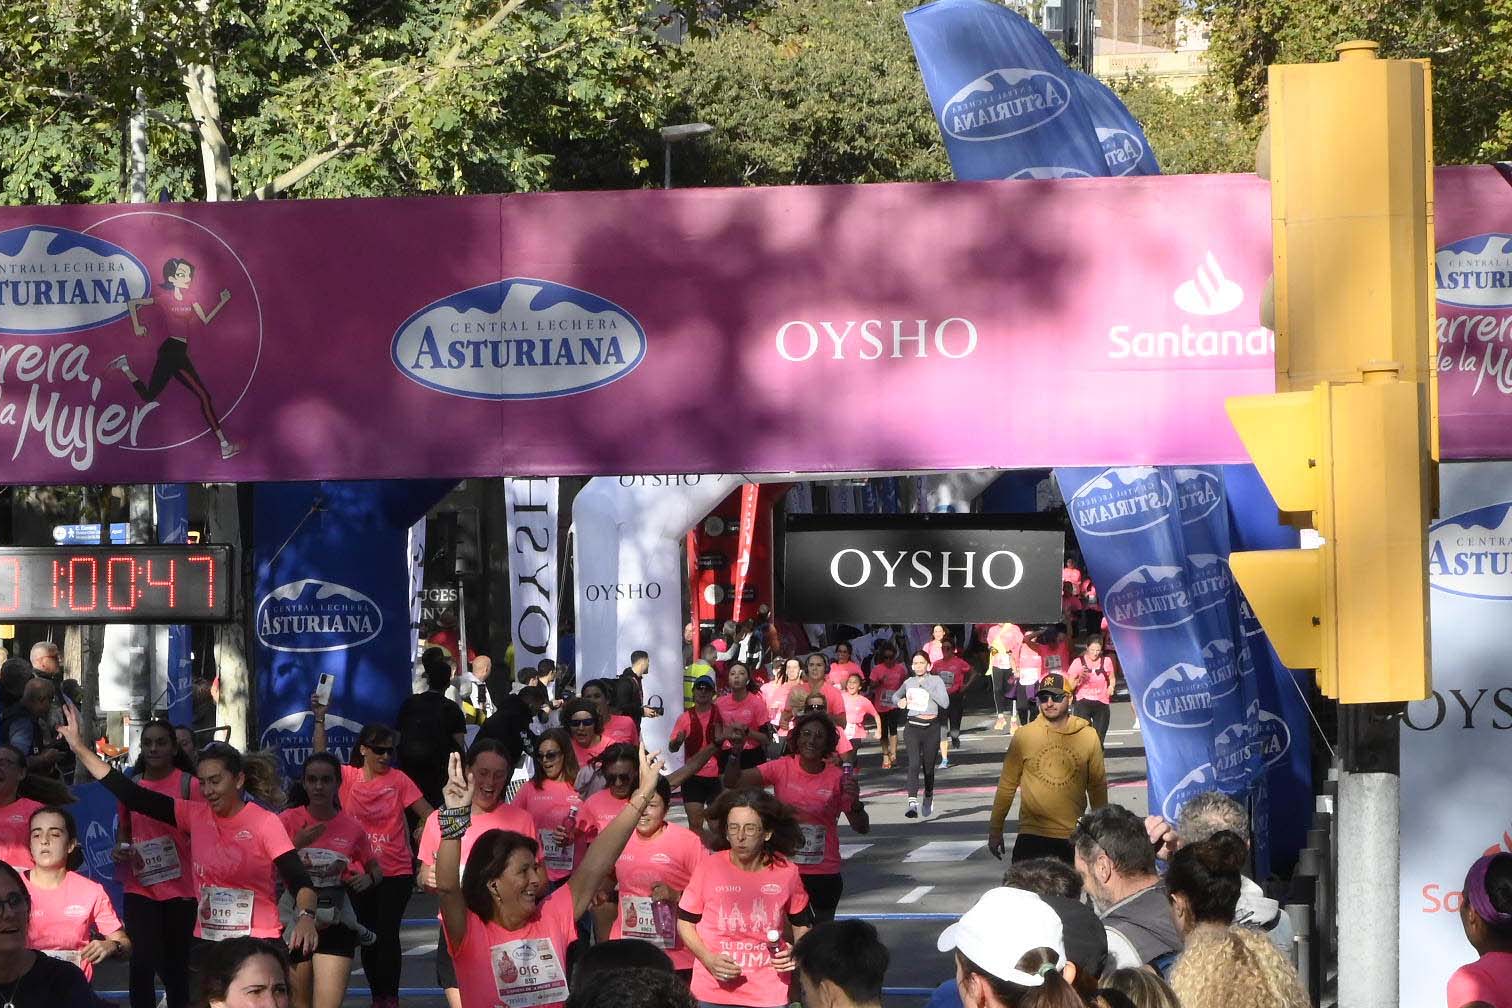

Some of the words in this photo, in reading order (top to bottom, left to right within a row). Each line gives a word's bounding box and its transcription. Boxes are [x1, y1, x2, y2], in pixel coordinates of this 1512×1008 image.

[53, 261, 126, 273] LECHERA
[450, 321, 530, 334] CENTRAL
[537, 318, 619, 332] LECHERA
[775, 318, 978, 361] OYSHO
[412, 325, 626, 370] ASTURIANA
[13, 378, 160, 471] Mujer
[830, 548, 1025, 591] OYSHO
[586, 581, 662, 603] OYSHO
[261, 610, 374, 636] ASTURIANA
